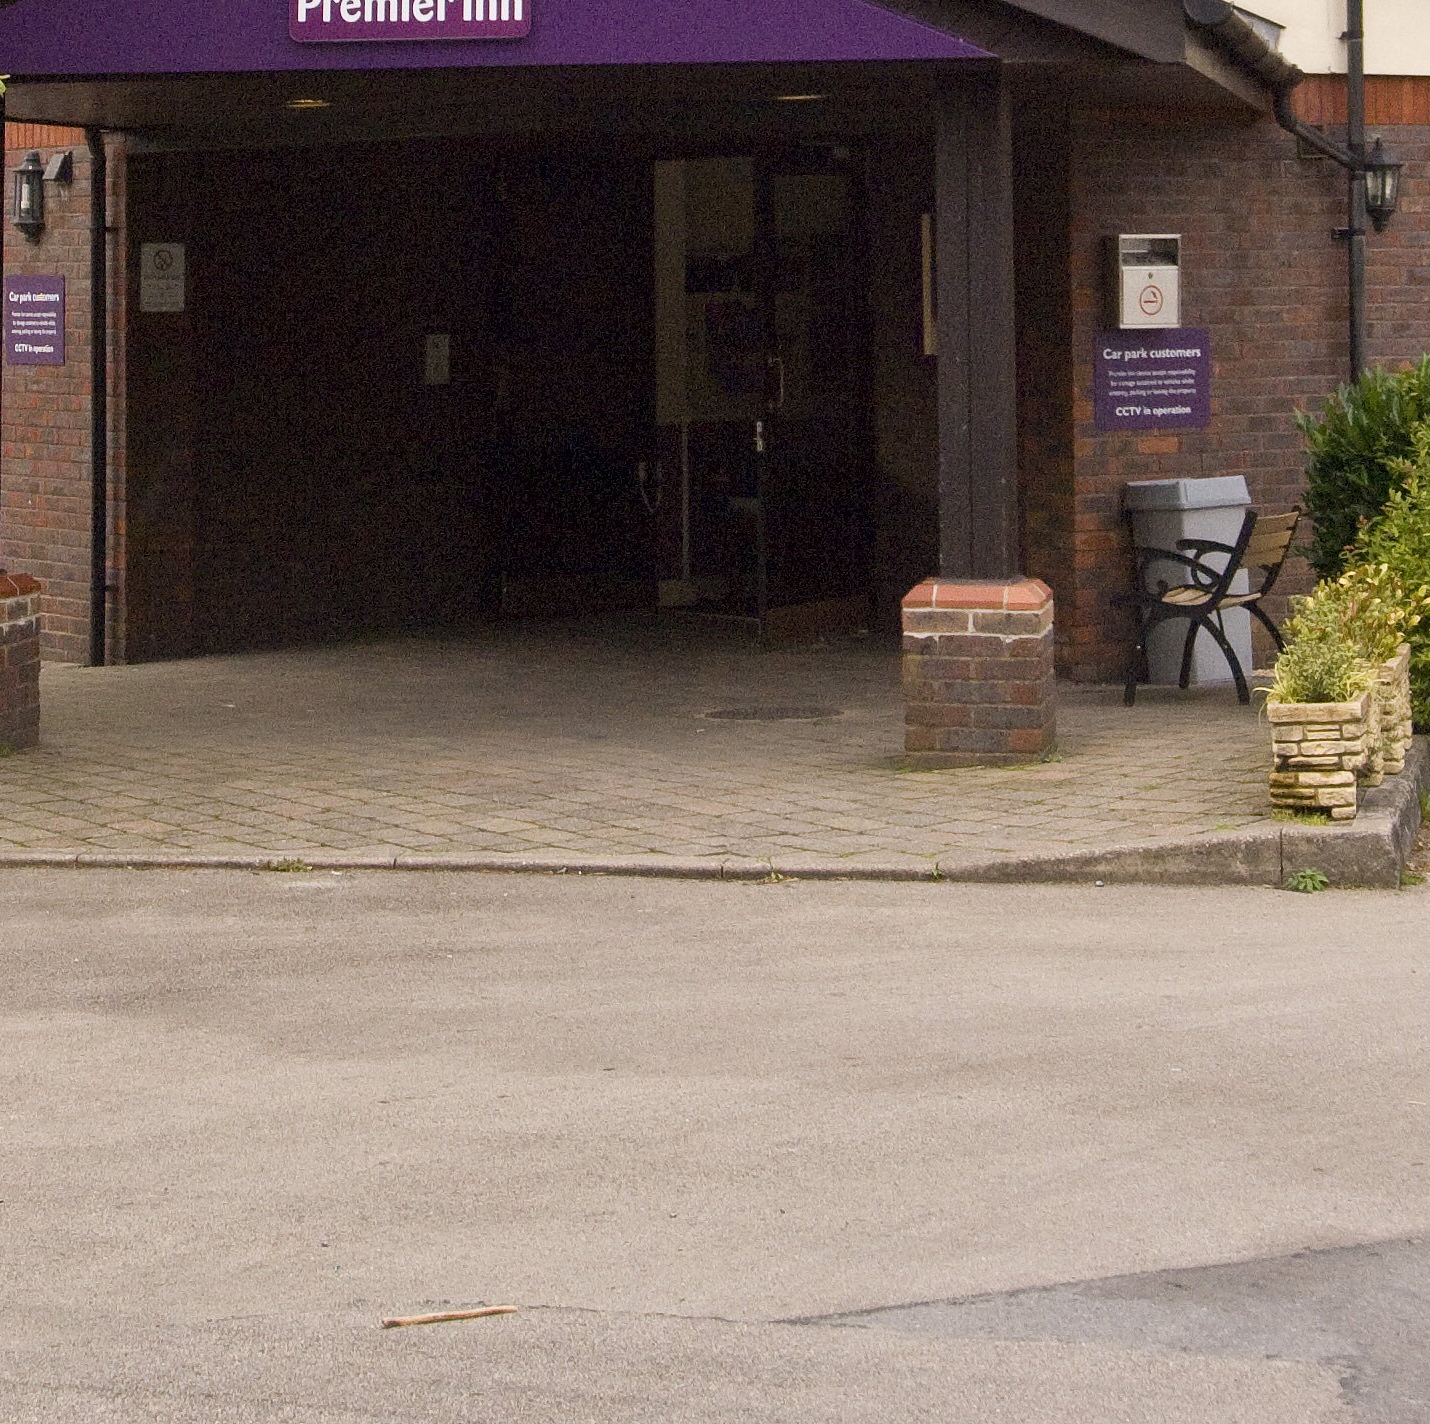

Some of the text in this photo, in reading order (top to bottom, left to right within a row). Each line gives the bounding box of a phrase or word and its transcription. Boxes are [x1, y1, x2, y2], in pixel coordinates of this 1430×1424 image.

[9, 291, 60, 304] Car park customers
[14, 343, 28, 353] CCTV
[33, 344, 54, 355] operation
[1103, 347, 1201, 362] Car park customers
[1115, 404, 1192, 418] CCTV in operation
